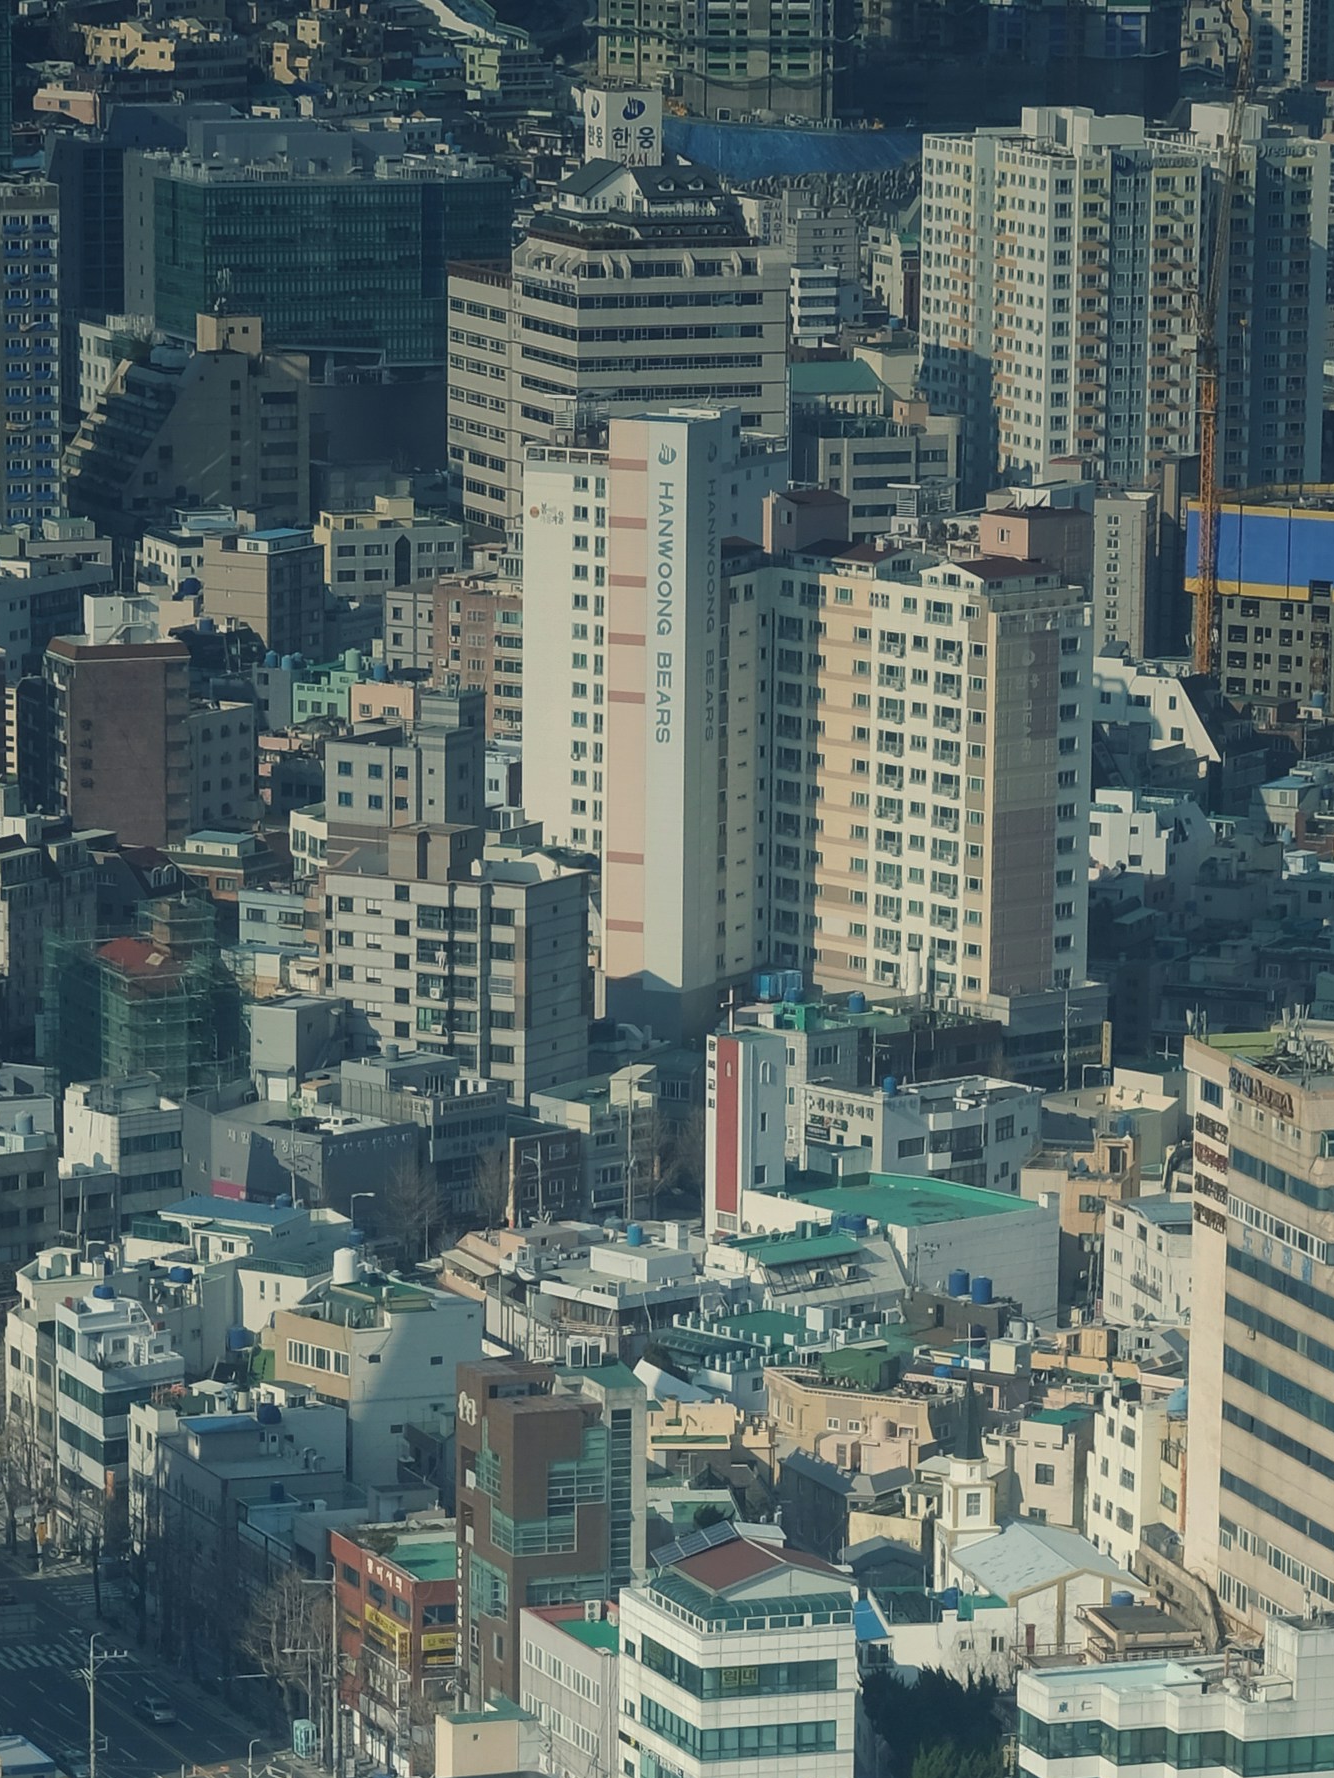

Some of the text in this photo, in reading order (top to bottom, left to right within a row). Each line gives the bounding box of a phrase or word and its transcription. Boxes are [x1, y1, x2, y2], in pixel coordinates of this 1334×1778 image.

[611, 126, 654, 150] 한웅
[655, 480, 675, 744] HANWOONG BEARS
[704, 479, 716, 742] HANWOONG BEARS
